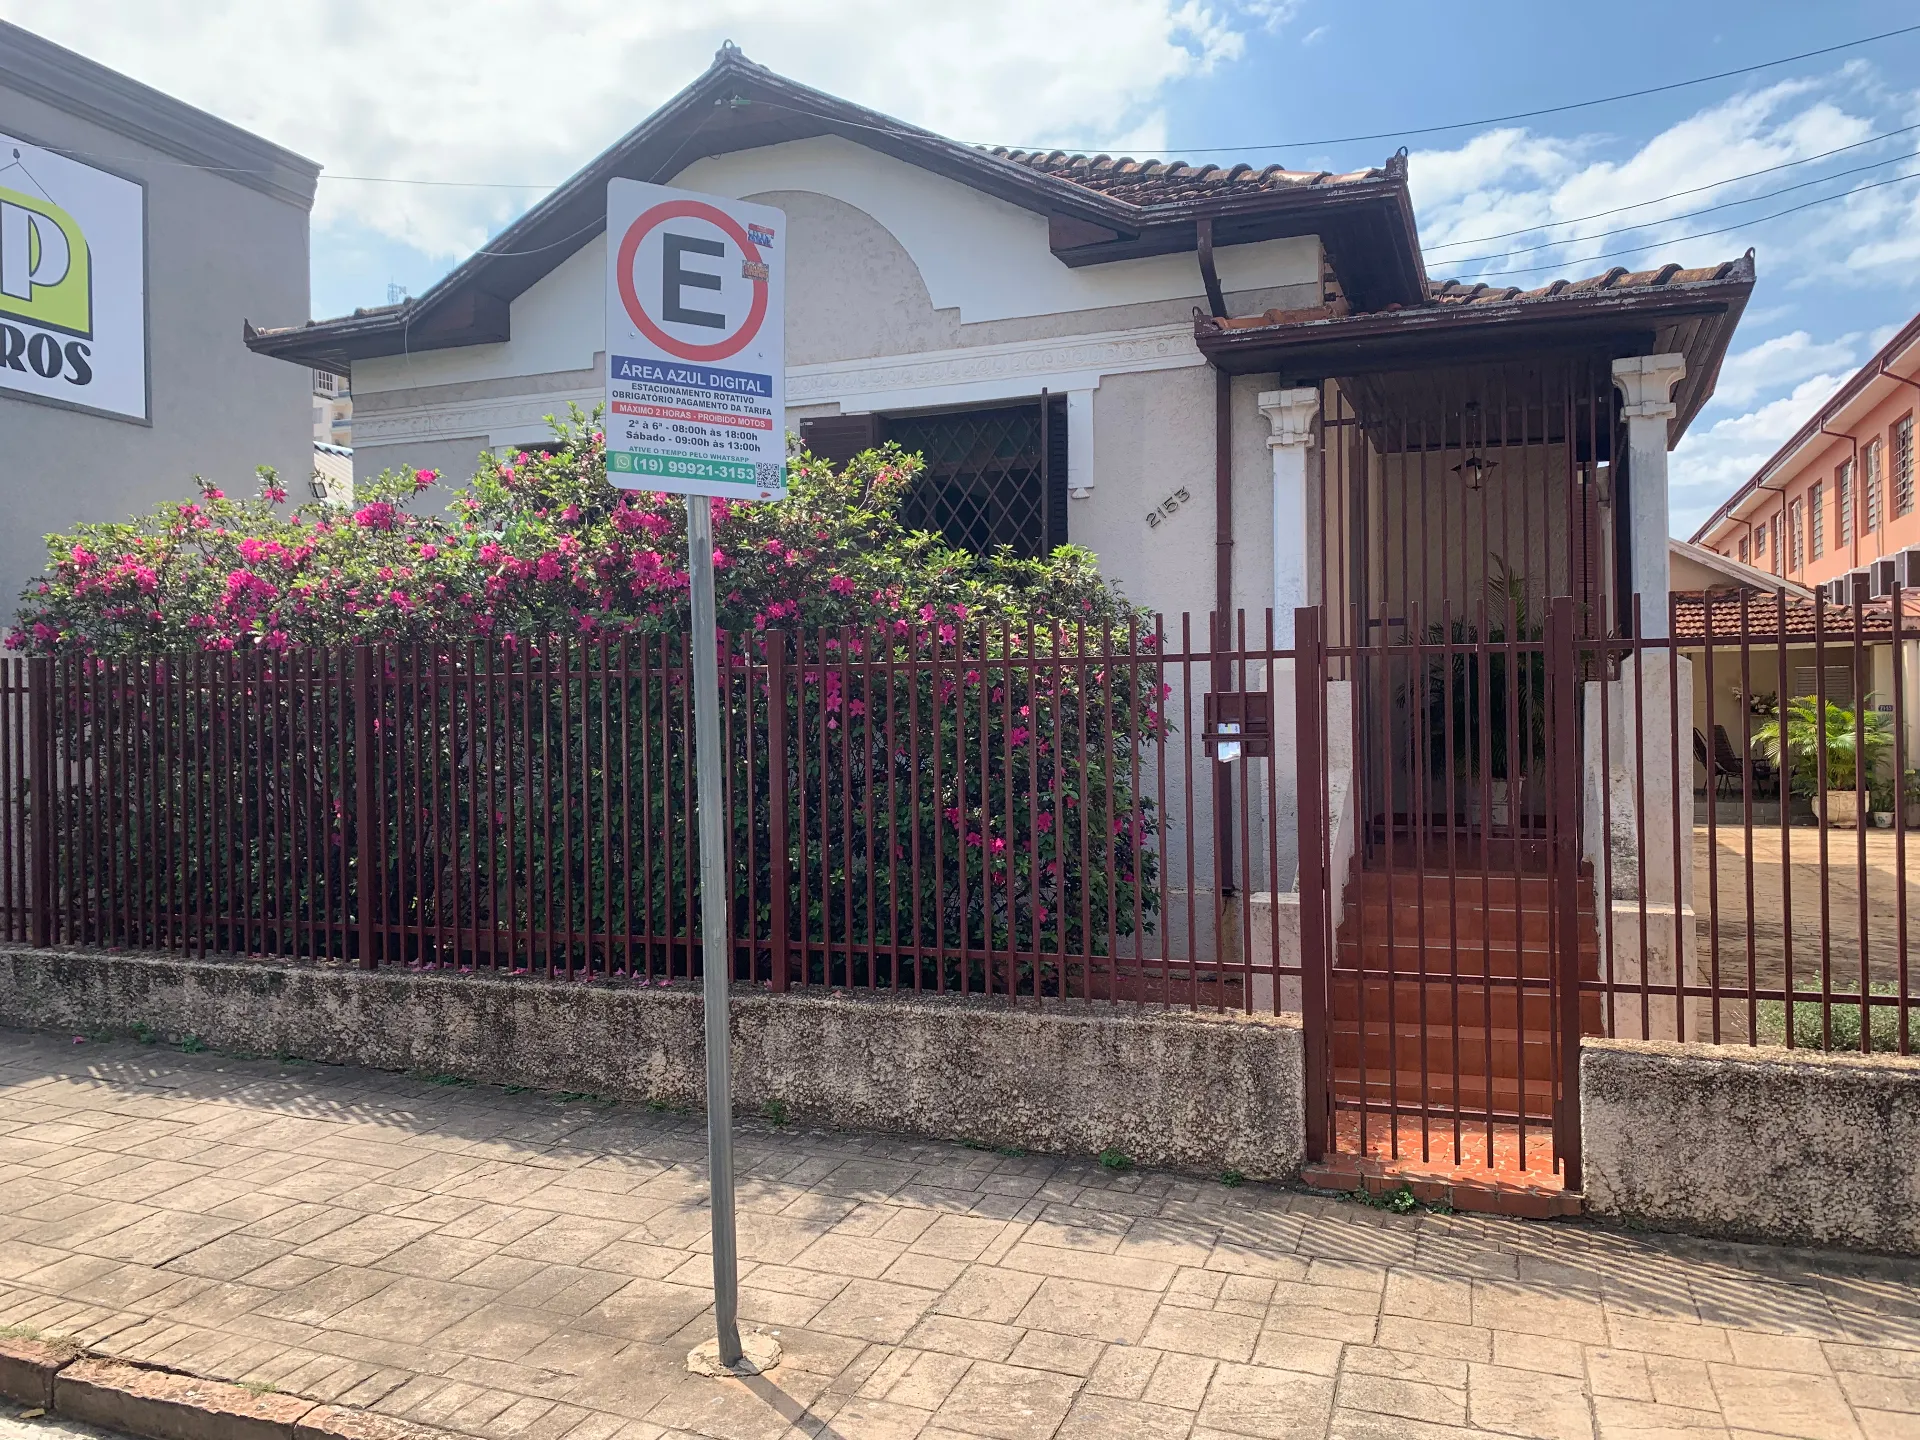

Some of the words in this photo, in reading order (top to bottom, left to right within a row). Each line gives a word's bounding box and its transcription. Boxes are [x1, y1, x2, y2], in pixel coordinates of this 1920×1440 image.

[0, 199, 71, 302] P
[662, 232, 726, 330] E
[620, 361, 664, 380] ÁREA
[666, 369, 706, 386] AZUL
[710, 374, 765, 393] DIGITAL
[612, 390, 674, 404] OBRIGATÓRIO
[676, 397, 728, 411] PAGAMENTO
[730, 404, 742, 412] DA
[744, 406, 772, 416] TARIFA
[632, 382, 712, 398] ESTACIONAMENTO
[714, 392, 754, 404] ROTATIVO
[620, 404, 654, 415] MÁXIMO
[662, 409, 692, 419] HORAS
[698, 412, 736, 424] PROIBIDO
[738, 418, 766, 428] MOTOS
[626, 430, 666, 442] Sábado
[675, 436, 710, 447] 09:00h
[728, 442, 760, 452] 13:00h
[672, 424, 706, 436] 08:00h
[710, 428, 722, 436] às
[724, 430, 758, 441] 18:00h
[628, 446, 652, 454] ATIVE
[661, 448, 688, 456] TEMPO
[710, 454, 750, 462] WHATSAPP
[633, 456, 664, 472] (19)
[668, 461, 755, 480] 99921-3153
[1145, 486, 1191, 529] 2153
